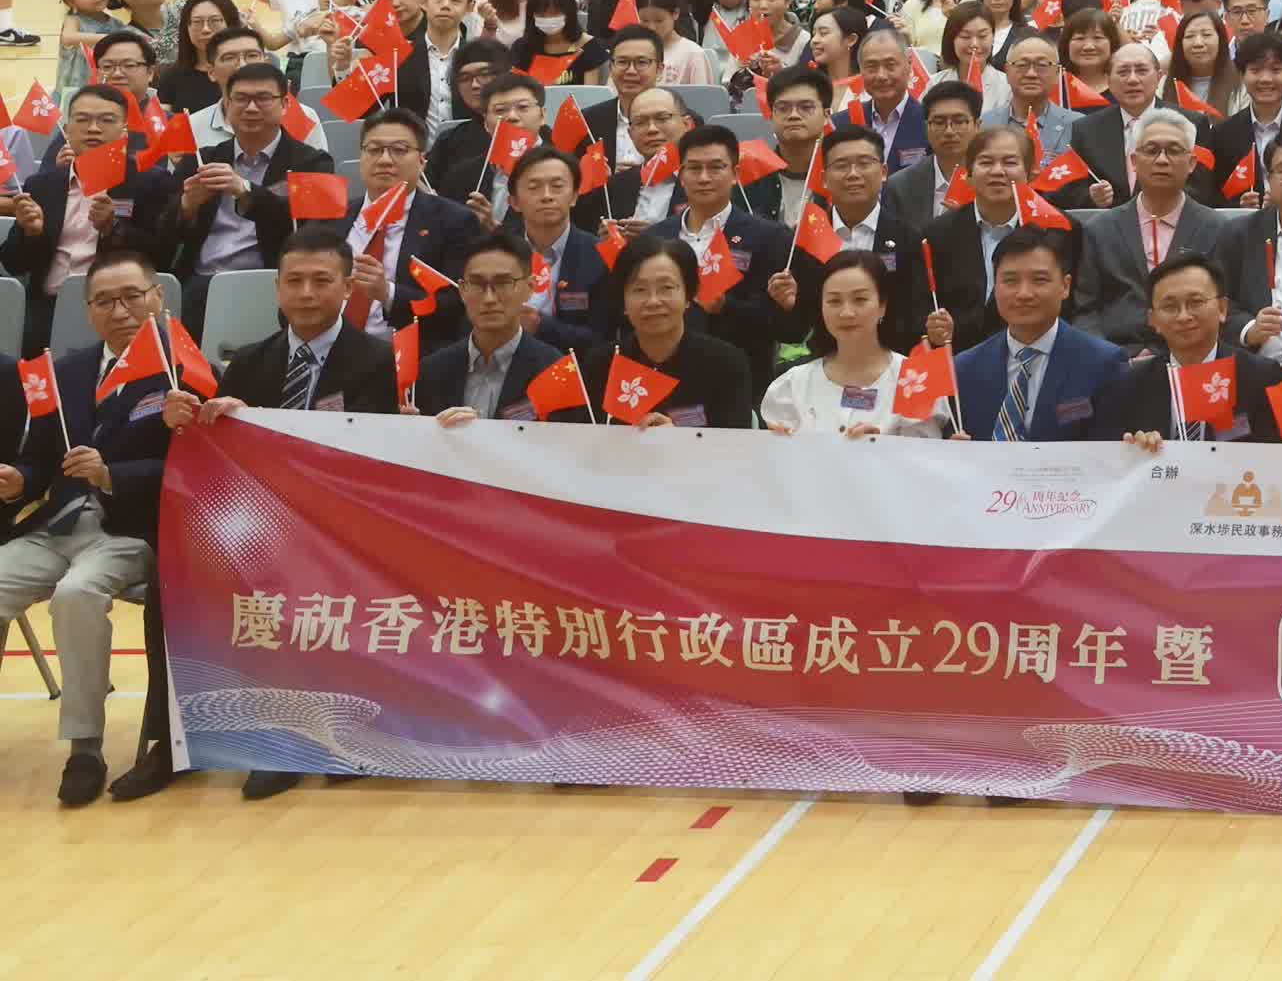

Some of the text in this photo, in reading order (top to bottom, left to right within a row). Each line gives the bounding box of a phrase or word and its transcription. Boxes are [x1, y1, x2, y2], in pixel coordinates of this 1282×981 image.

[1151, 466, 1179, 480] 合辦
[1024, 501, 1090, 515] ANNIVERSARY
[231, 590, 1214, 686] 慶祝香港特別行政區成立29周年 暨
